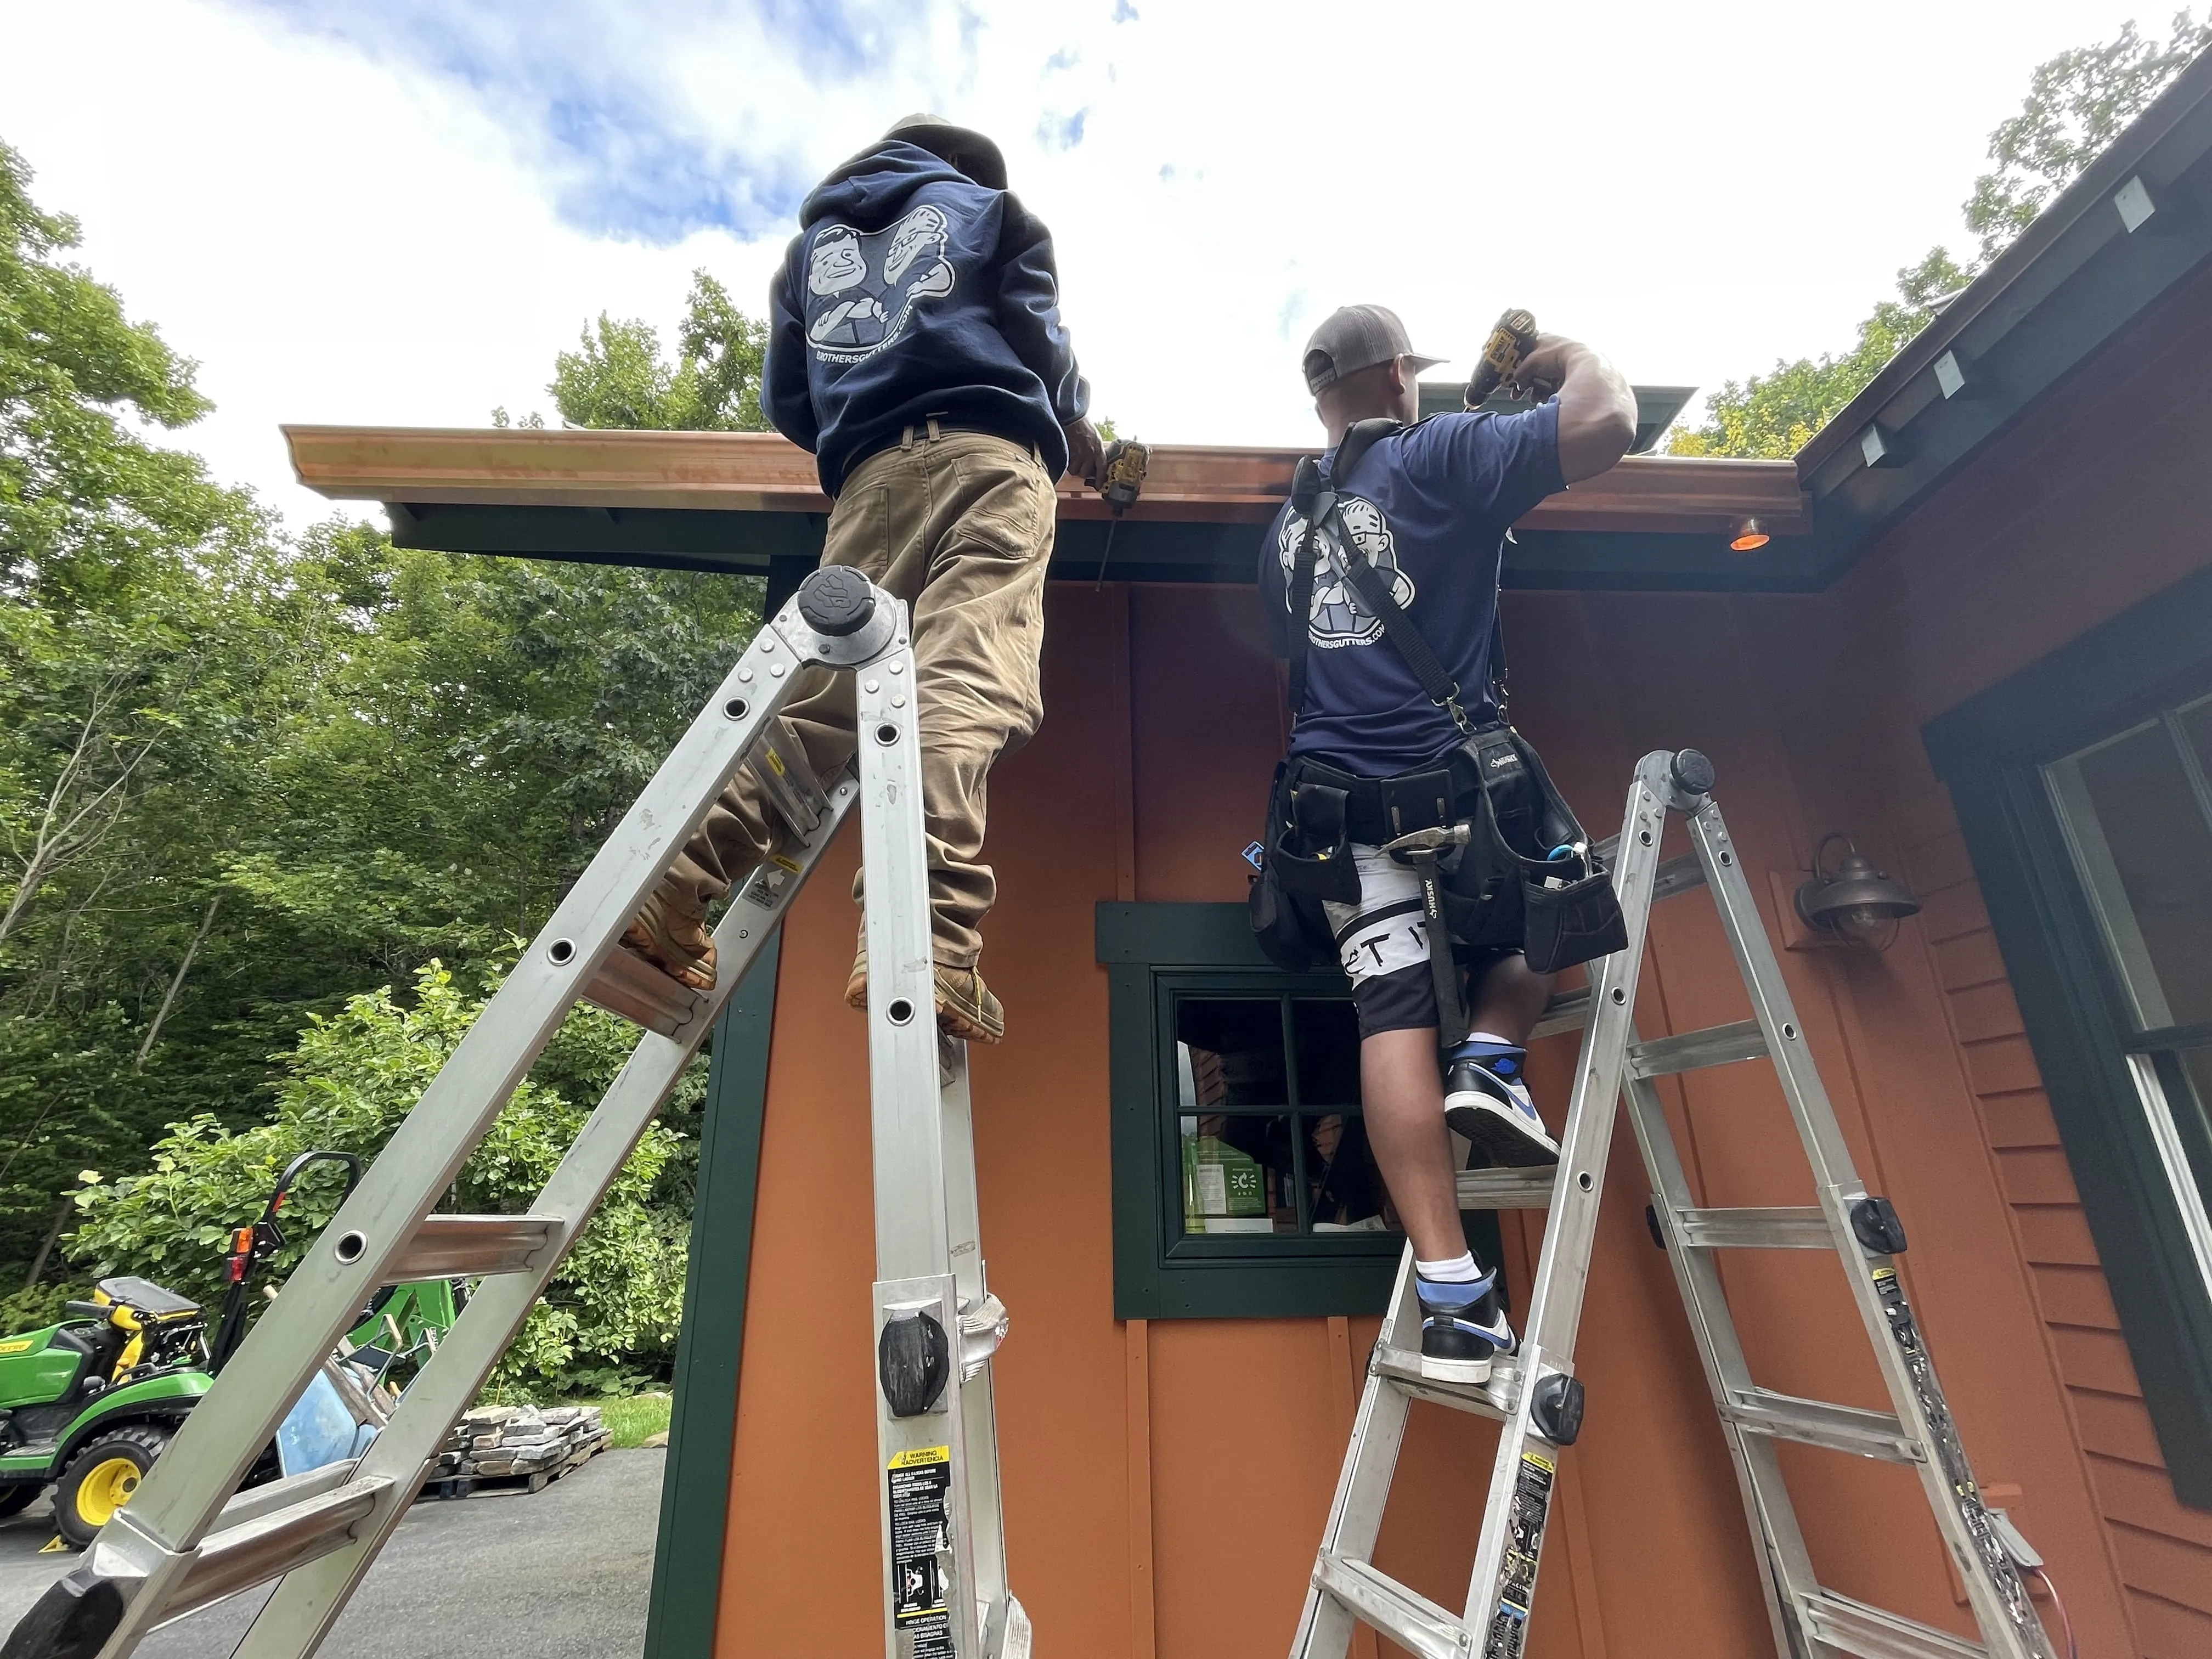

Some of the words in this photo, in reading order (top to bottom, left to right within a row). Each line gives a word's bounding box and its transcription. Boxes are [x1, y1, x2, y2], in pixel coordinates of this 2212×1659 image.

[816, 304, 913, 364] BROTHERSGUTTERS.COM
[1425, 879, 1436, 909] HUSKY
[910, 1450, 937, 1459] WARNING
